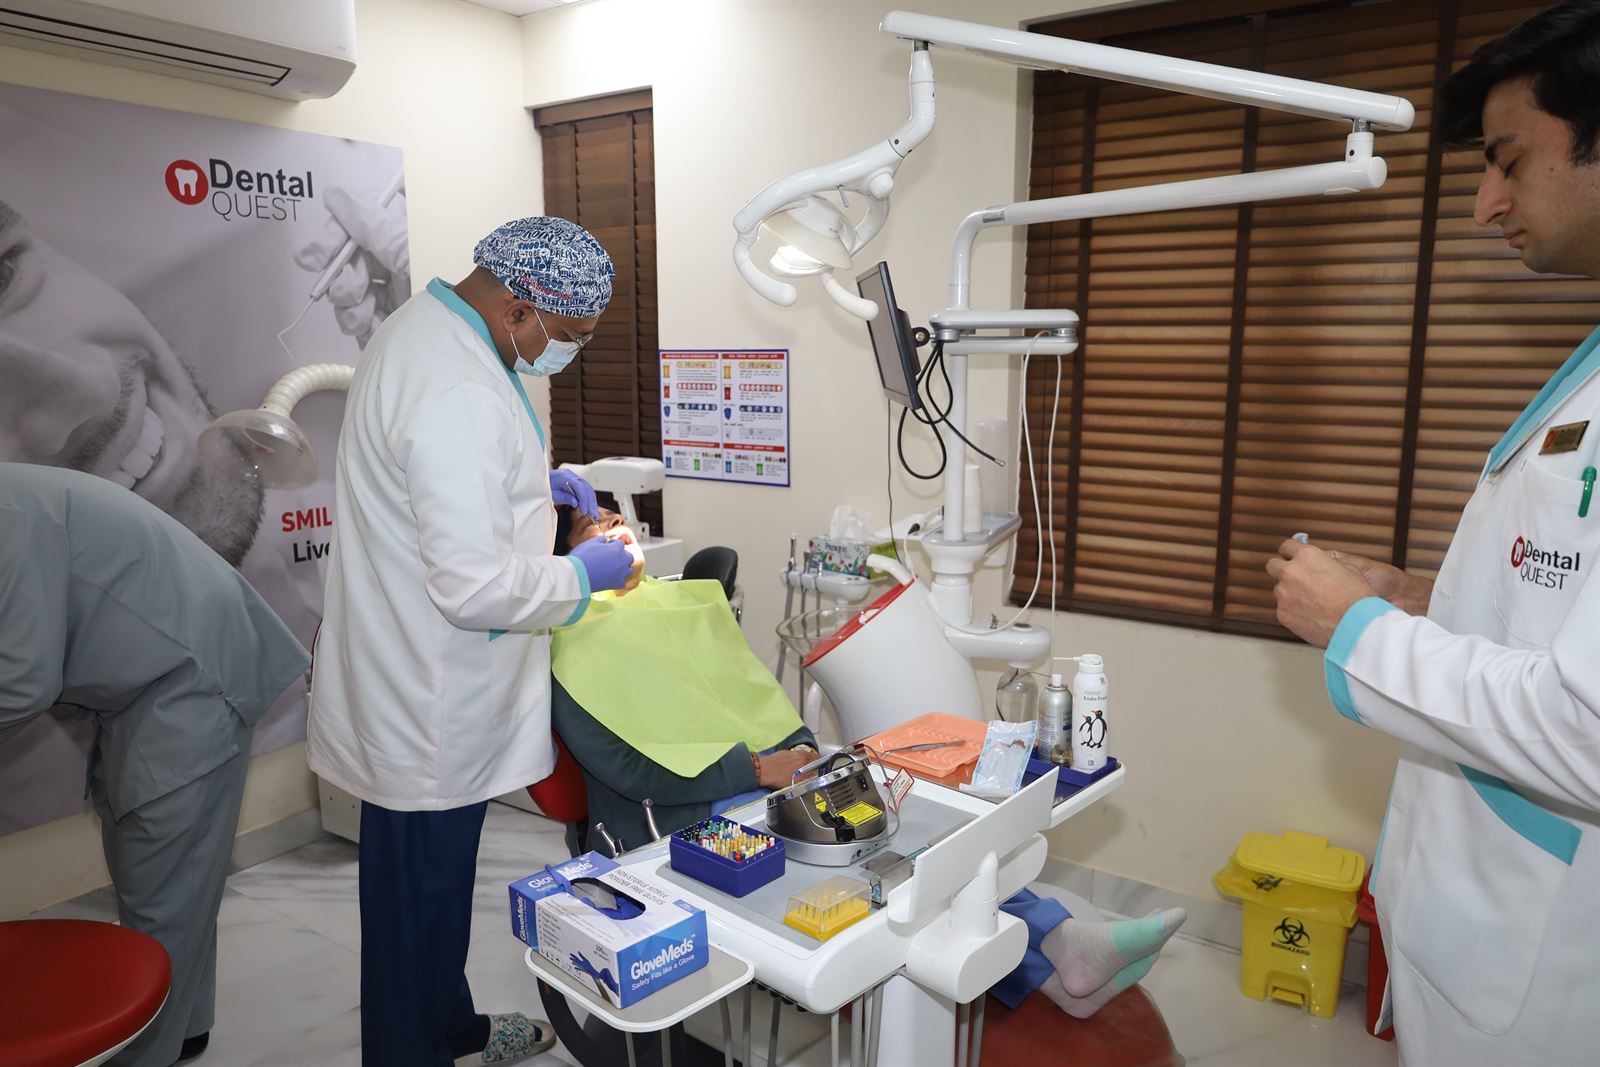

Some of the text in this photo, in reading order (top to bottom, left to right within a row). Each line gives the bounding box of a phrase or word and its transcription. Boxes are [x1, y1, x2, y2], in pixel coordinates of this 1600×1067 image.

[209, 158, 314, 198] Dental
[212, 190, 301, 222] QUEST
[1524, 540, 1580, 571] Dental
[1520, 561, 1568, 590] QUEST
[628, 884, 645, 895] FREE
[643, 892, 666, 906] GLOVES
[630, 938, 694, 980] GloveMeds
[1271, 942, 1310, 956] BIOHAZARD
[631, 977, 651, 991] Safety
[651, 971, 662, 981] Fits
[662, 965, 673, 975] like
[678, 954, 695, 966] Glove
